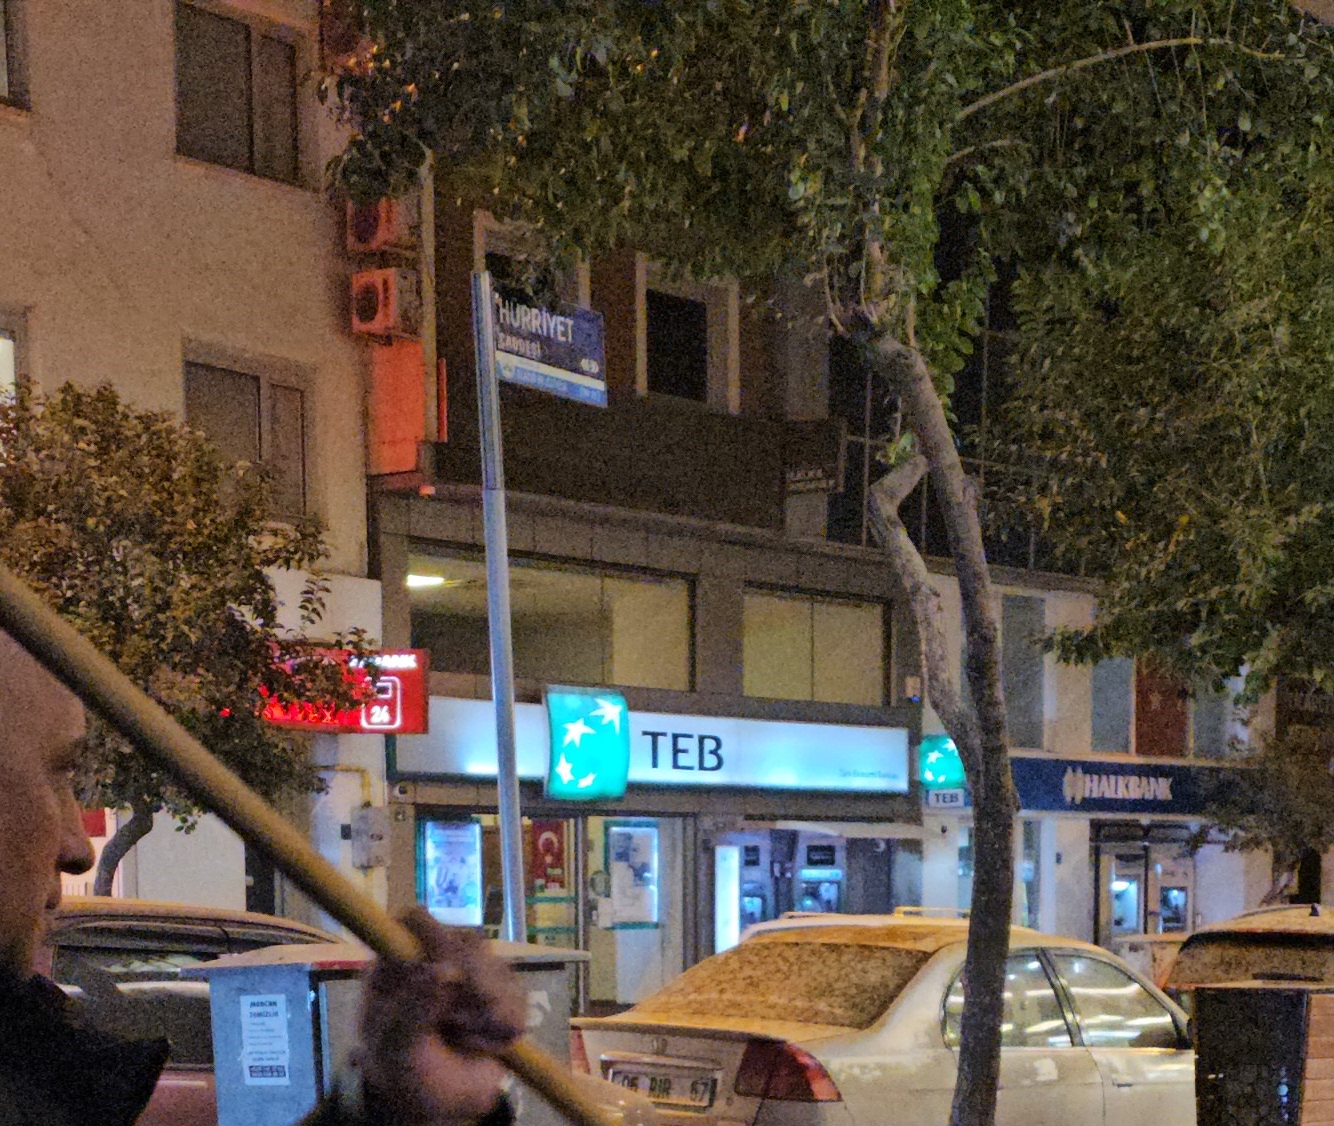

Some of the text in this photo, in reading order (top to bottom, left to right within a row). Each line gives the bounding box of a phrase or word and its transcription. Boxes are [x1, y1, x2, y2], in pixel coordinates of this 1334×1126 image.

[641, 730, 725, 772] TEB
[934, 792, 959, 804] TEB
[1083, 773, 1173, 800] HALKBANK
